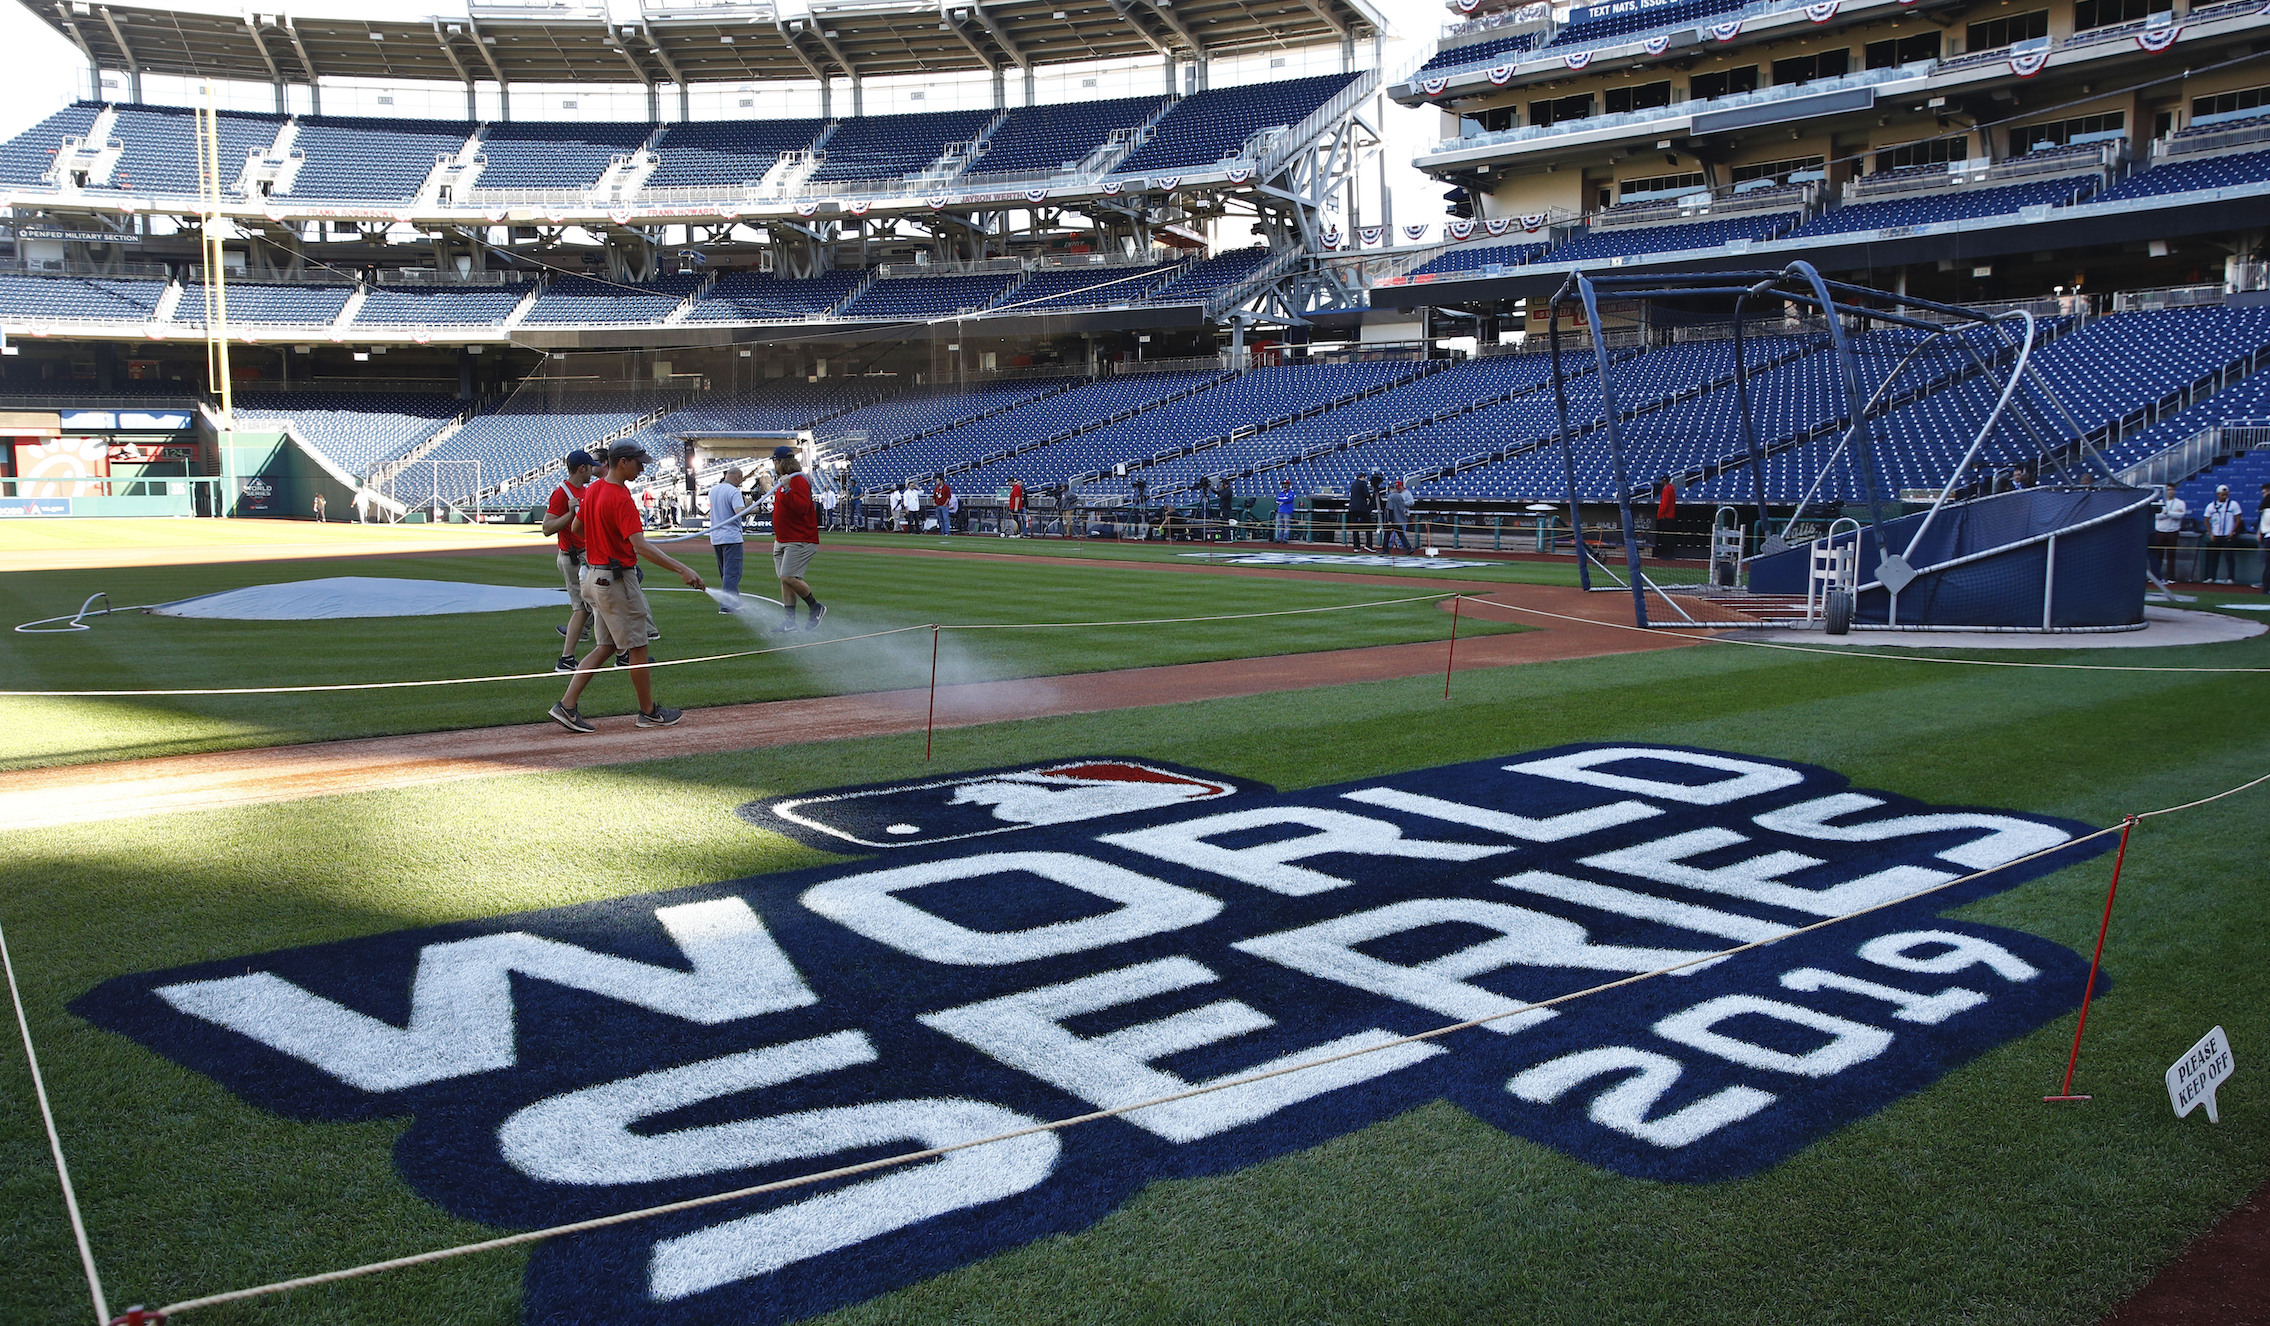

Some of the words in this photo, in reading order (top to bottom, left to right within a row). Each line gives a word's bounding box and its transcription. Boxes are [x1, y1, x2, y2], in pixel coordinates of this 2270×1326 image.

[1588, 5, 1610, 18] TEXT
[1612, 1, 1639, 14] NATS,
[648, 209, 674, 217] FRANK
[678, 208, 716, 216] HOWARD
[961, 195, 991, 203] JAYSON
[994, 192, 1023, 200] WERTH
[28, 230, 62, 238] PENFED
[65, 232, 102, 240] MILITARY
[164, 449, 184, 457] 124
[153, 747, 1804, 1093] WORLD
[500, 792, 2072, 1302] SERIES
[1505, 929, 2042, 1149] 2019
[2178, 1037, 2218, 1084] PLEASE
[2178, 1072, 2207, 1109] KEEP
[2208, 1051, 2228, 1080] OFF
